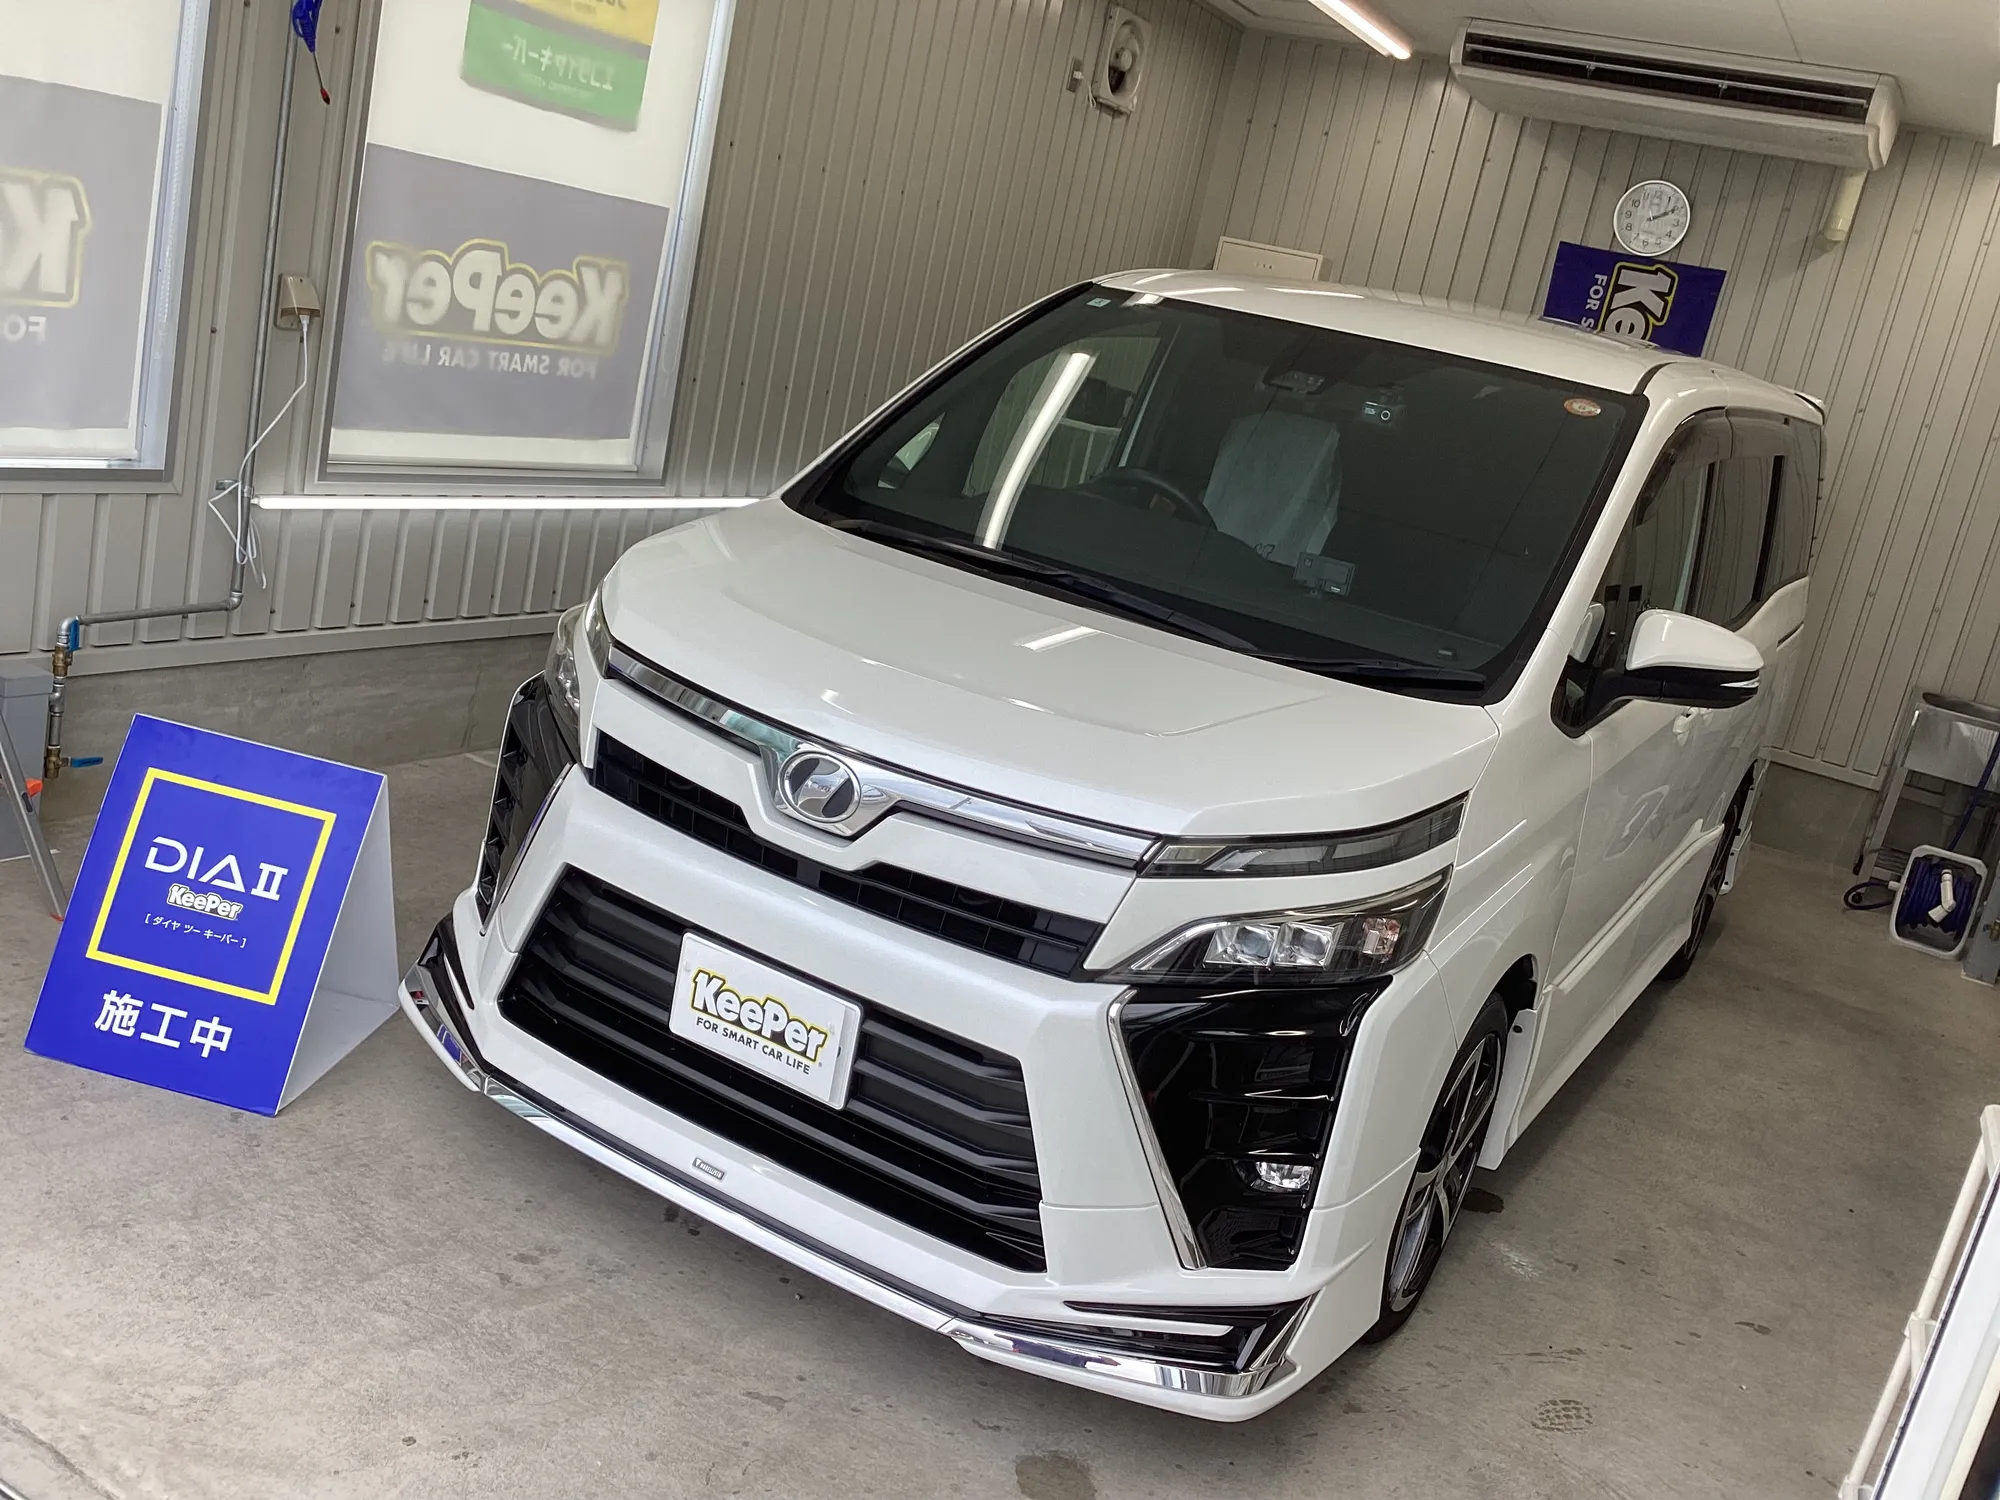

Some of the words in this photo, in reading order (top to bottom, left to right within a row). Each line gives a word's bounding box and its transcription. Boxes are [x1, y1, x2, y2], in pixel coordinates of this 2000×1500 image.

[1625, 210, 1632, 218] 9
[1632, 199, 1641, 208] 10
[1625, 223, 1632, 231] 8
[1665, 230, 1672, 238] 4
[1673, 219, 1680, 227] 3
[1642, 239, 1649, 247] 6
[1585, 274, 1608, 310] FOR
[145, 836, 246, 893] DIA
[167, 883, 244, 921] KeePer
[95, 990, 233, 1058] 施工中
[692, 970, 828, 1061] KeePer
[696, 1016, 719, 1034] FOR
[722, 1027, 760, 1050] SMART
[761, 1044, 783, 1061] CAR
[786, 1055, 810, 1075] LIFE
